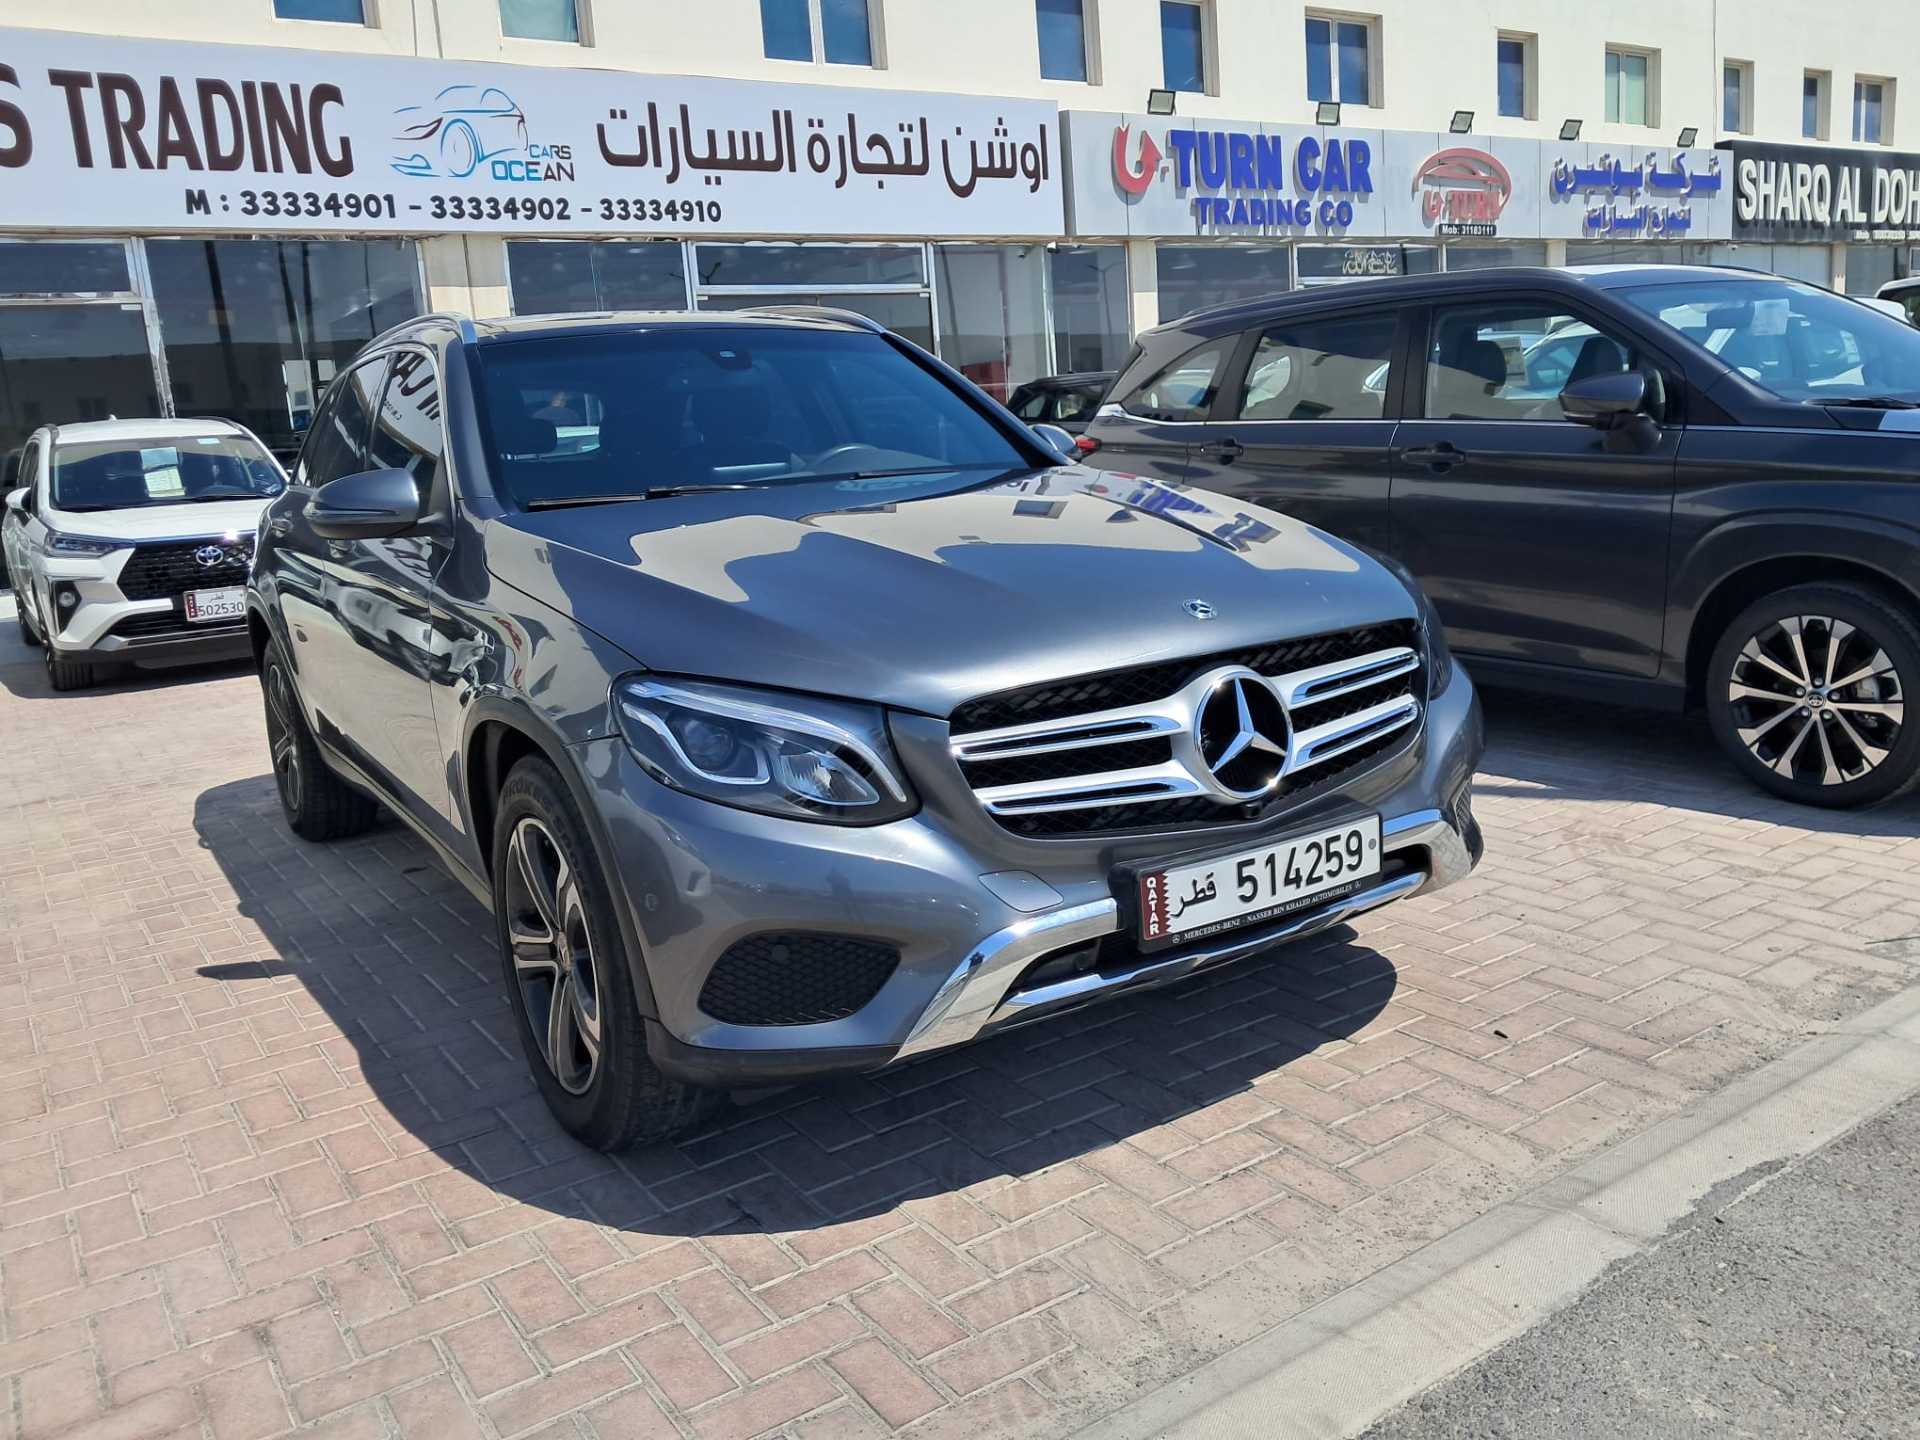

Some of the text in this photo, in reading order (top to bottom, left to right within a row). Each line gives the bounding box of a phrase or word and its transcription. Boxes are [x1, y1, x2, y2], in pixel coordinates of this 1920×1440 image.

[48, 69, 354, 177] TRADING
[491, 160, 575, 182] OCEAN
[529, 144, 572, 160] CARS
[596, 101, 1049, 198] اوشن لتجارة السيارات
[1299, 136, 1374, 193] CAR
[185, 188, 211, 216] M
[241, 190, 397, 219] 33334901
[430, 193, 572, 221] 33334902
[599, 198, 722, 223] 33334910
[1194, 198, 1354, 227] TRADING CO
[1736, 158, 1832, 227] SHARQ
[1835, 166, 1868, 223] AL
[197, 601, 245, 617] 502530
[1235, 829, 1363, 904] 514259
[1146, 876, 1160, 935] QATAR
[1170, 872, 1217, 918] قطر
[1184, 918, 1241, 940] MERCEDES-BENZ
